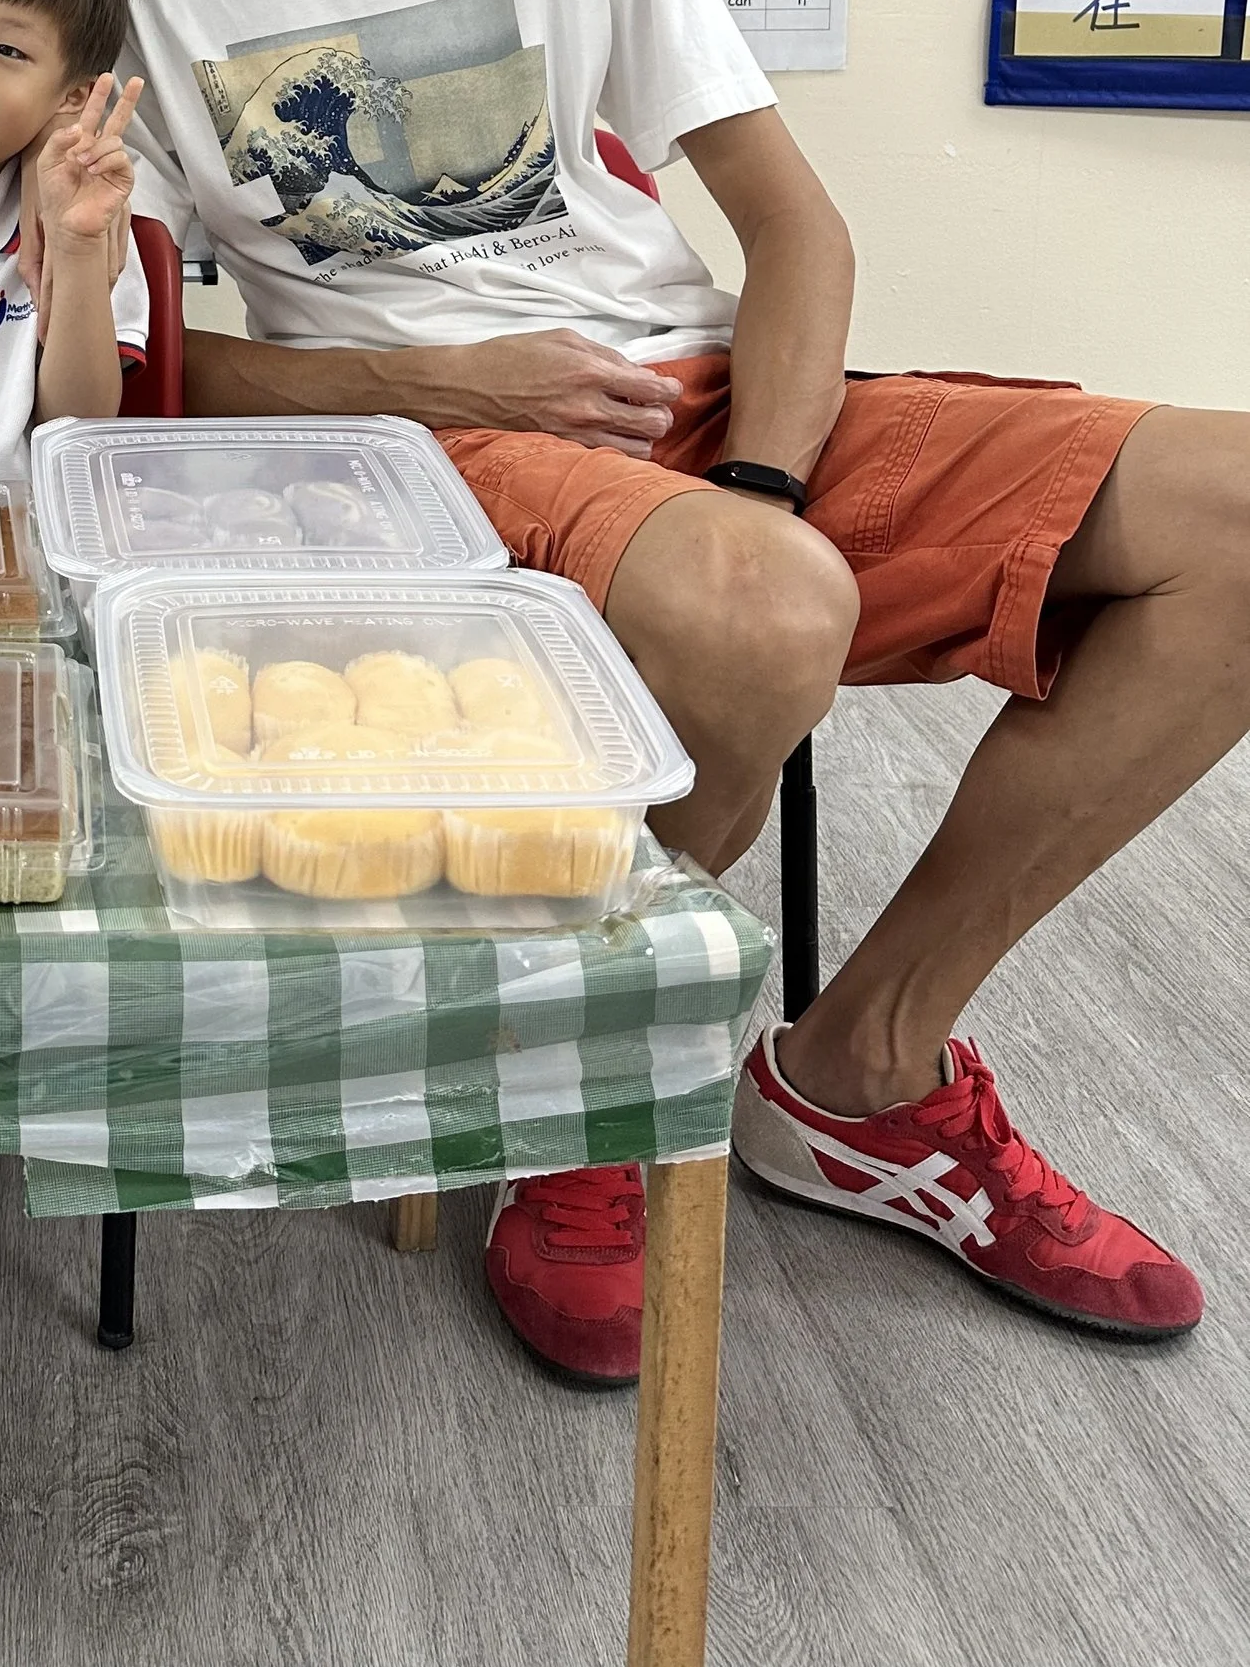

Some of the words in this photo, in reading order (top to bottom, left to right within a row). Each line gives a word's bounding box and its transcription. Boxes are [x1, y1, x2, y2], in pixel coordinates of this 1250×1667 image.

[493, 241, 506, 256] &
[511, 224, 576, 250] Bero-Ai
[538, 248, 569, 268] love
